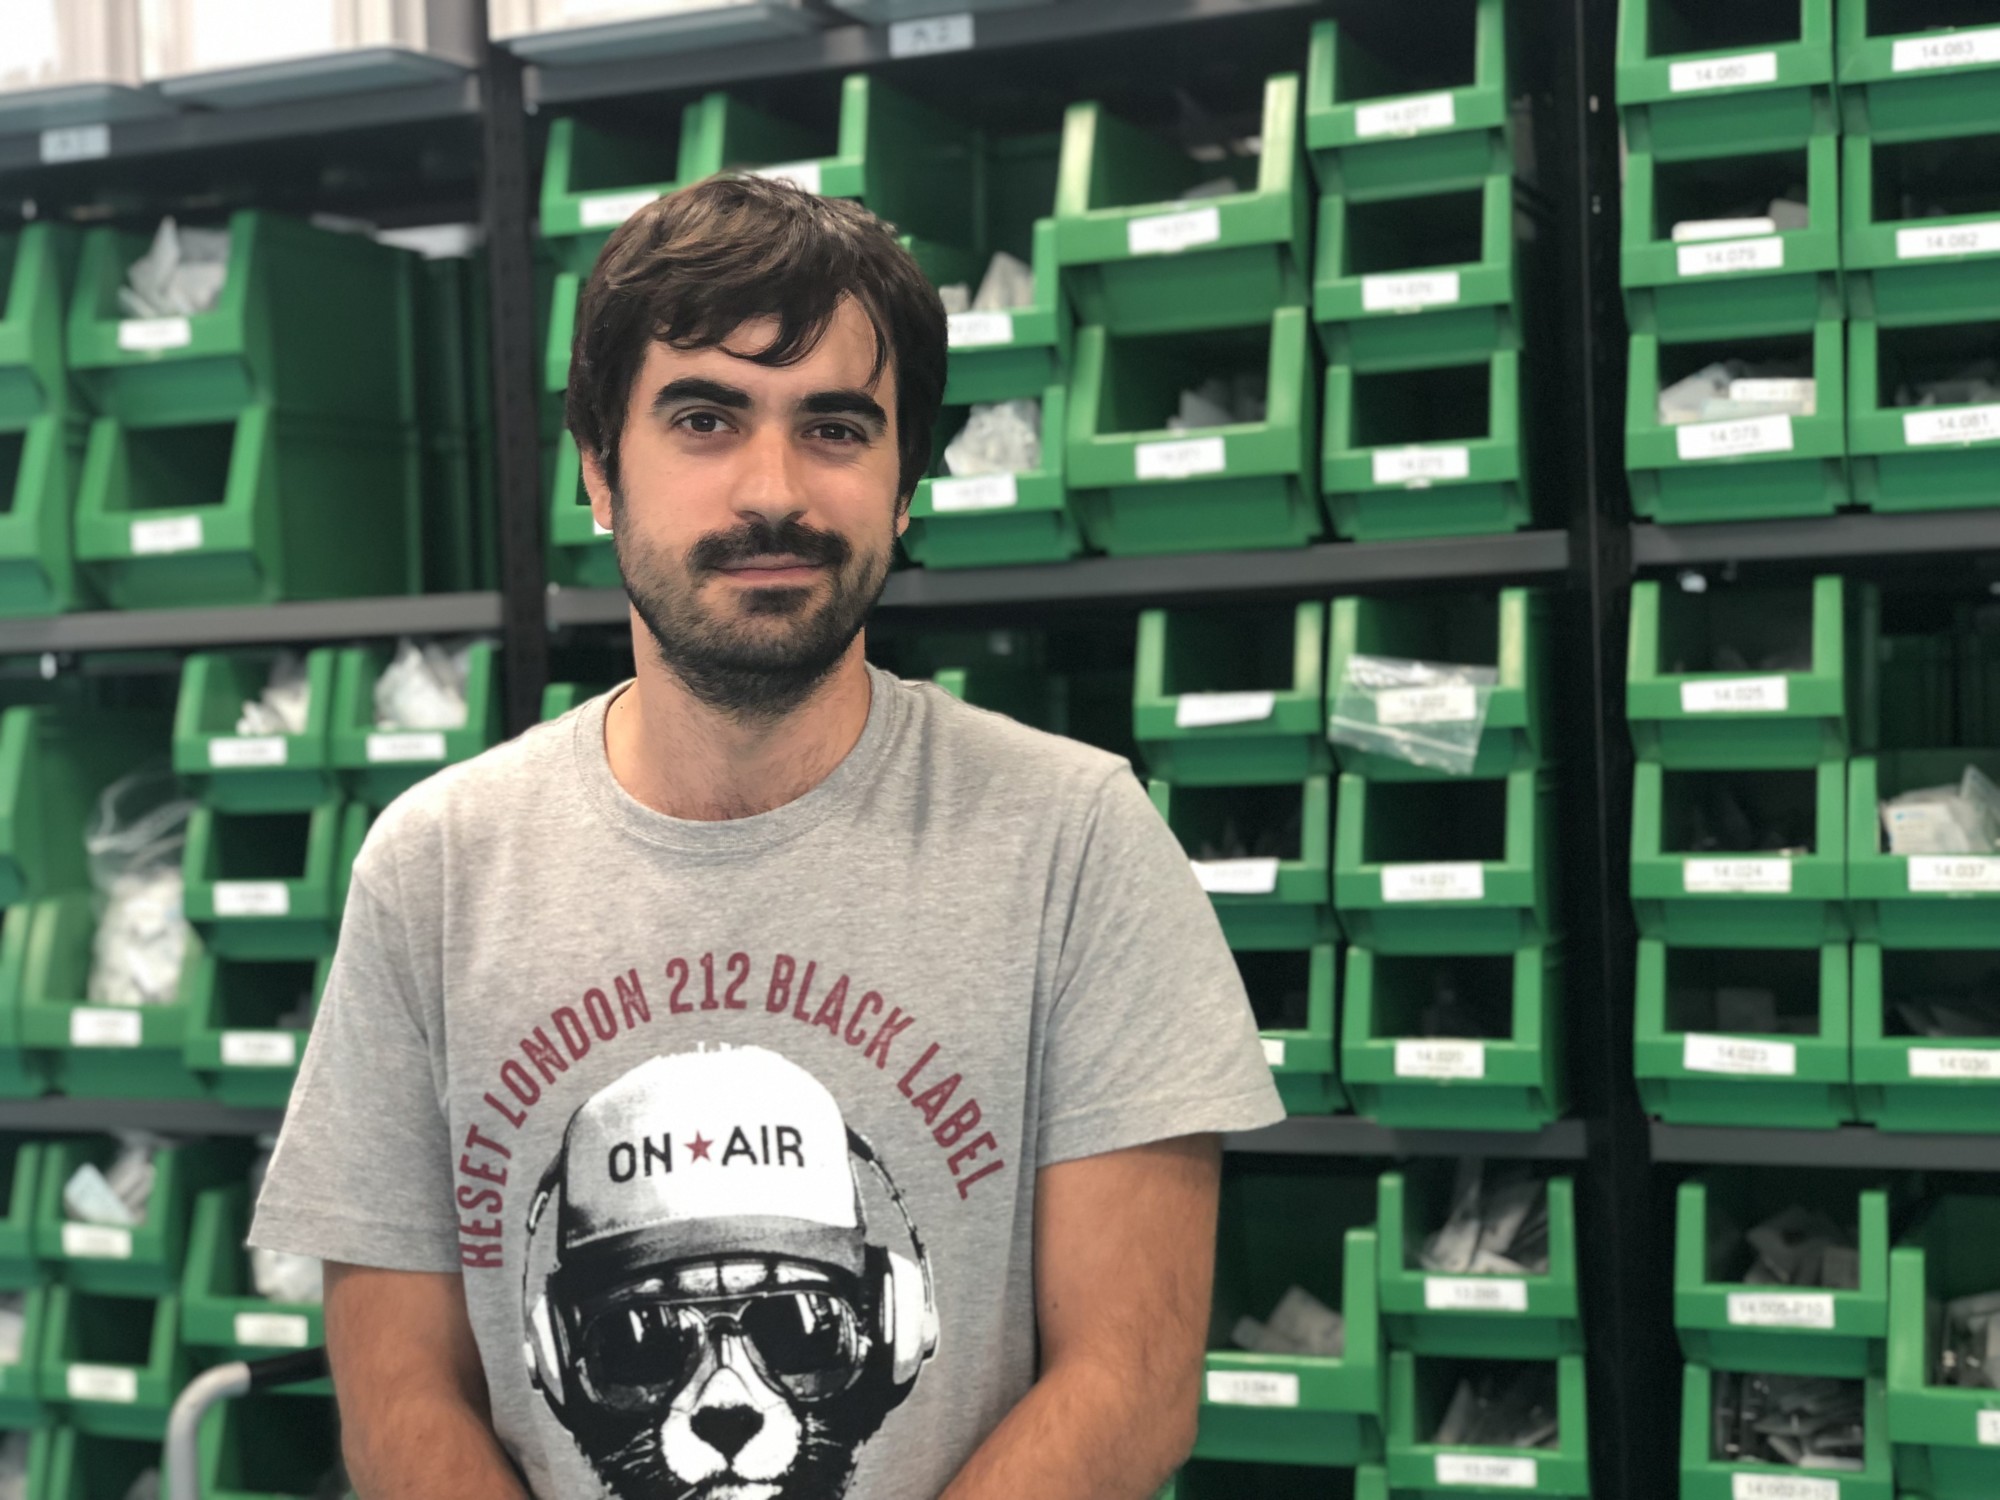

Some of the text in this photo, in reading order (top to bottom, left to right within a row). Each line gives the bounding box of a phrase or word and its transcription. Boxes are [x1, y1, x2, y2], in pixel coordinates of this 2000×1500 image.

[1937, 413, 1988, 430] 14.081
[457, 951, 1005, 1269] RESET LONDON 212 BLACK LABEL
[607, 1124, 805, 1184] ON AIR
